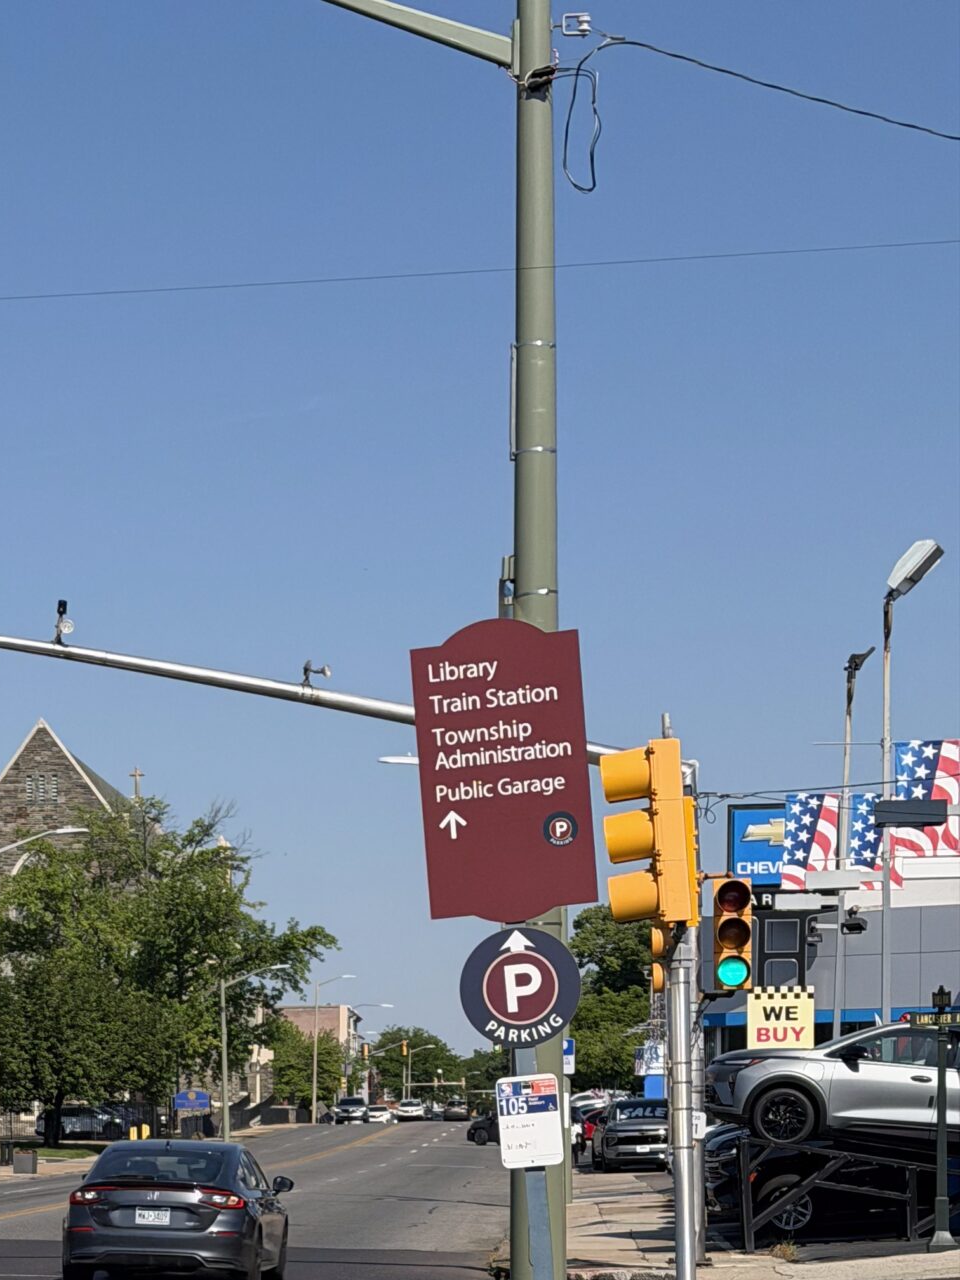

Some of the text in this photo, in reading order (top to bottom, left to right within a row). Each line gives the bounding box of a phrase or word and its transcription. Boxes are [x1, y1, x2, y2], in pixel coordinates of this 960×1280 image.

[428, 660, 498, 683] Library
[428, 684, 558, 715] Train Station
[431, 719, 532, 747] Township
[434, 740, 572, 771] Administration
[435, 776, 566, 803] Public Garage
[503, 963, 542, 1013] P
[762, 1006, 799, 1021] WE
[485, 1013, 564, 1042] PARKING
[756, 1026, 806, 1043] BUY
[500, 1097, 528, 1115] 105
[620, 1107, 668, 1118] SALE
